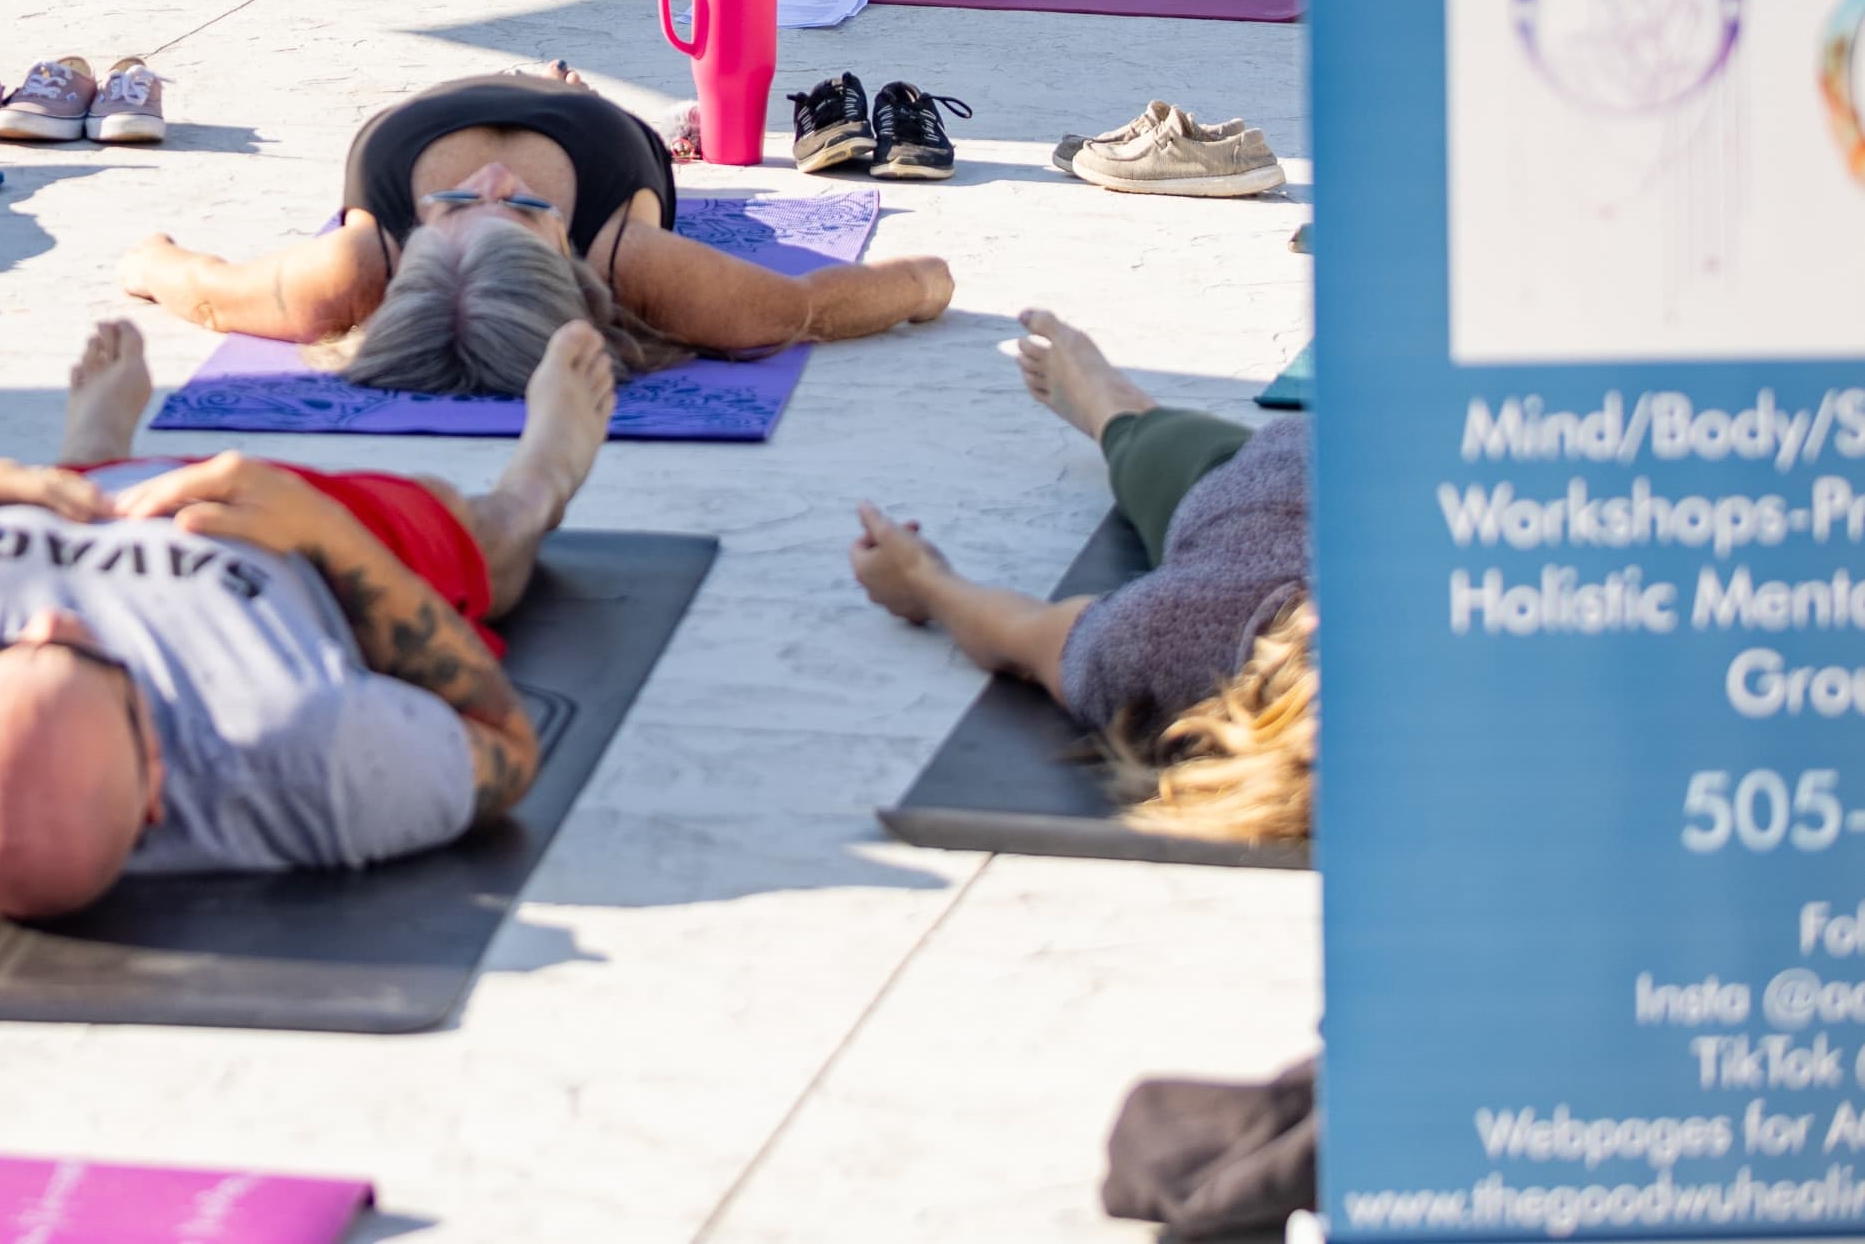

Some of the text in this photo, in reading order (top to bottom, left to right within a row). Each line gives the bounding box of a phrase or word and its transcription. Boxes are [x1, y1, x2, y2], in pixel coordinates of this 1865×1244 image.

[1449, 563, 1679, 636] Holistic
[1680, 769, 1865, 853] 505-
[1689, 1032, 1844, 1092] TikTok
[1474, 1103, 1734, 1171] Webpages
